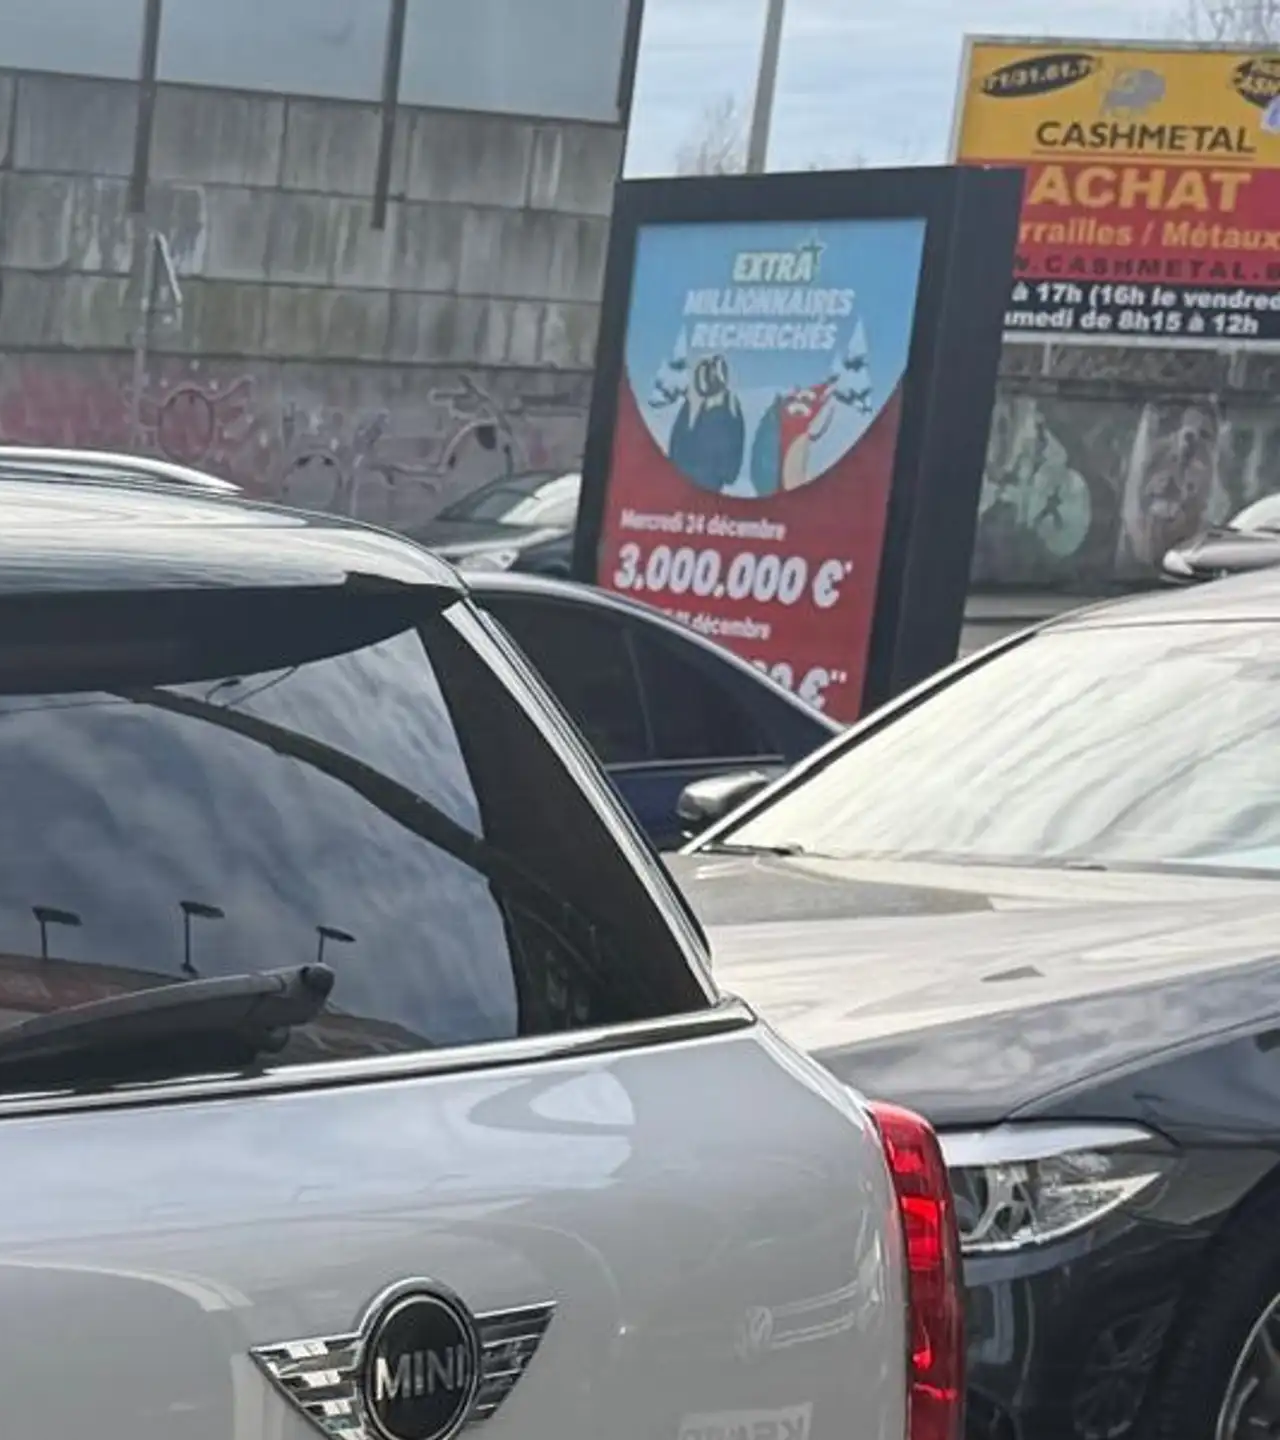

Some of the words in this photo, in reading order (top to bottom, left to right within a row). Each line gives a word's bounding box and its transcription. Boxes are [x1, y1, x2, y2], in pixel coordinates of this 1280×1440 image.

[1036, 120, 1256, 153] CASHMETAL
[1028, 164, 1252, 212] ACHAT
[732, 250, 814, 282] EXTRA
[1036, 281, 1083, 304] 17h
[1151, 286, 1177, 307] le
[1080, 309, 1112, 330] de
[1117, 309, 1182, 333] 8h15
[1211, 312, 1259, 334] 12h
[614, 542, 807, 605] 3.000.000
[375, 1342, 467, 1401] MINI
